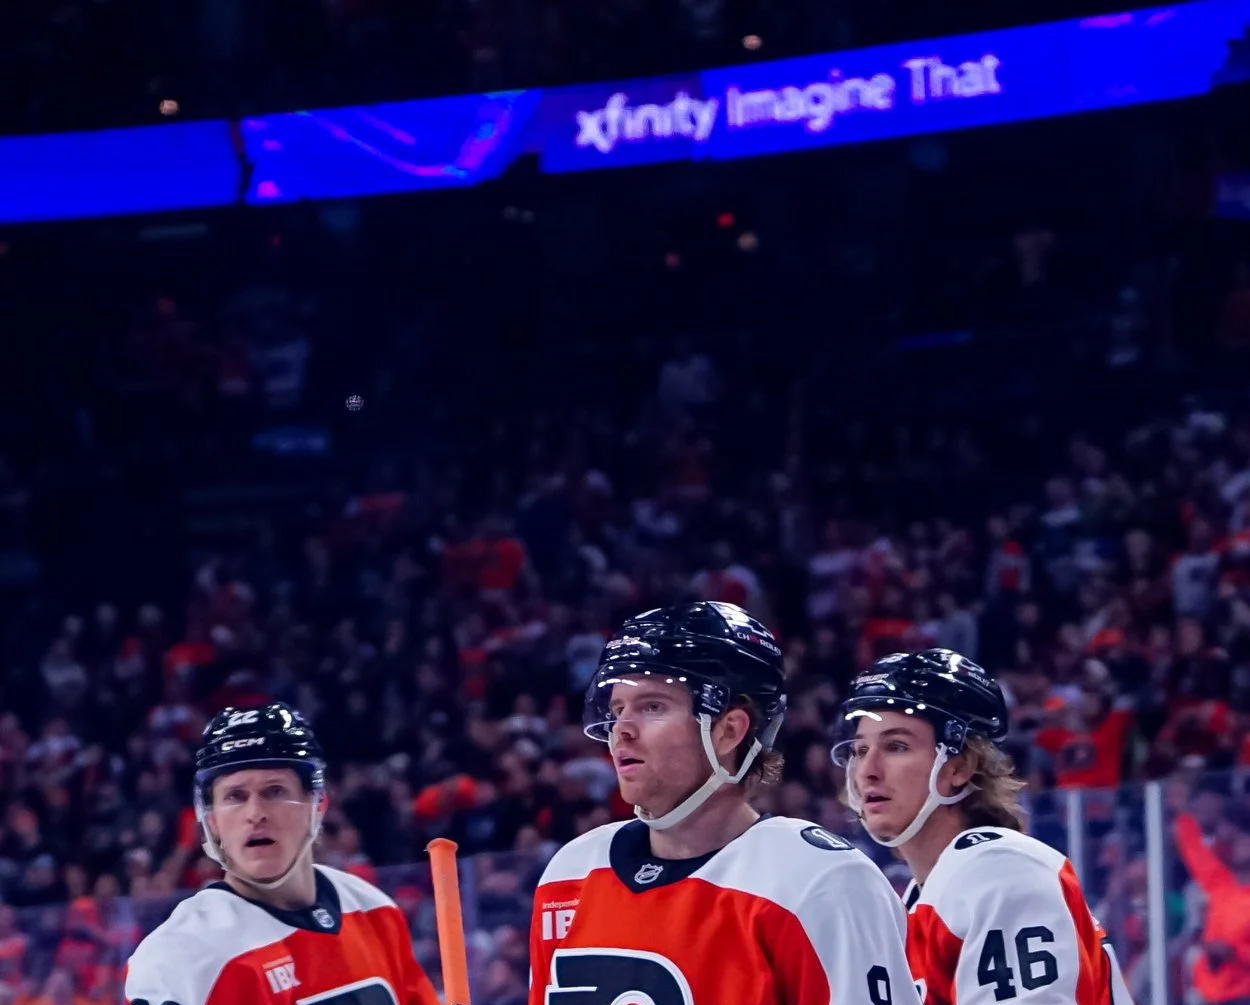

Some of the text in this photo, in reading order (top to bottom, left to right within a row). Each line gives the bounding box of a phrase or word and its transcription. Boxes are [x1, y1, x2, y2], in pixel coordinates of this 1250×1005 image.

[576, 53, 1002, 153] xfinity Imagine That
[221, 736, 266, 752] CCM
[541, 909, 577, 941] IB
[976, 925, 1059, 1002] 46
